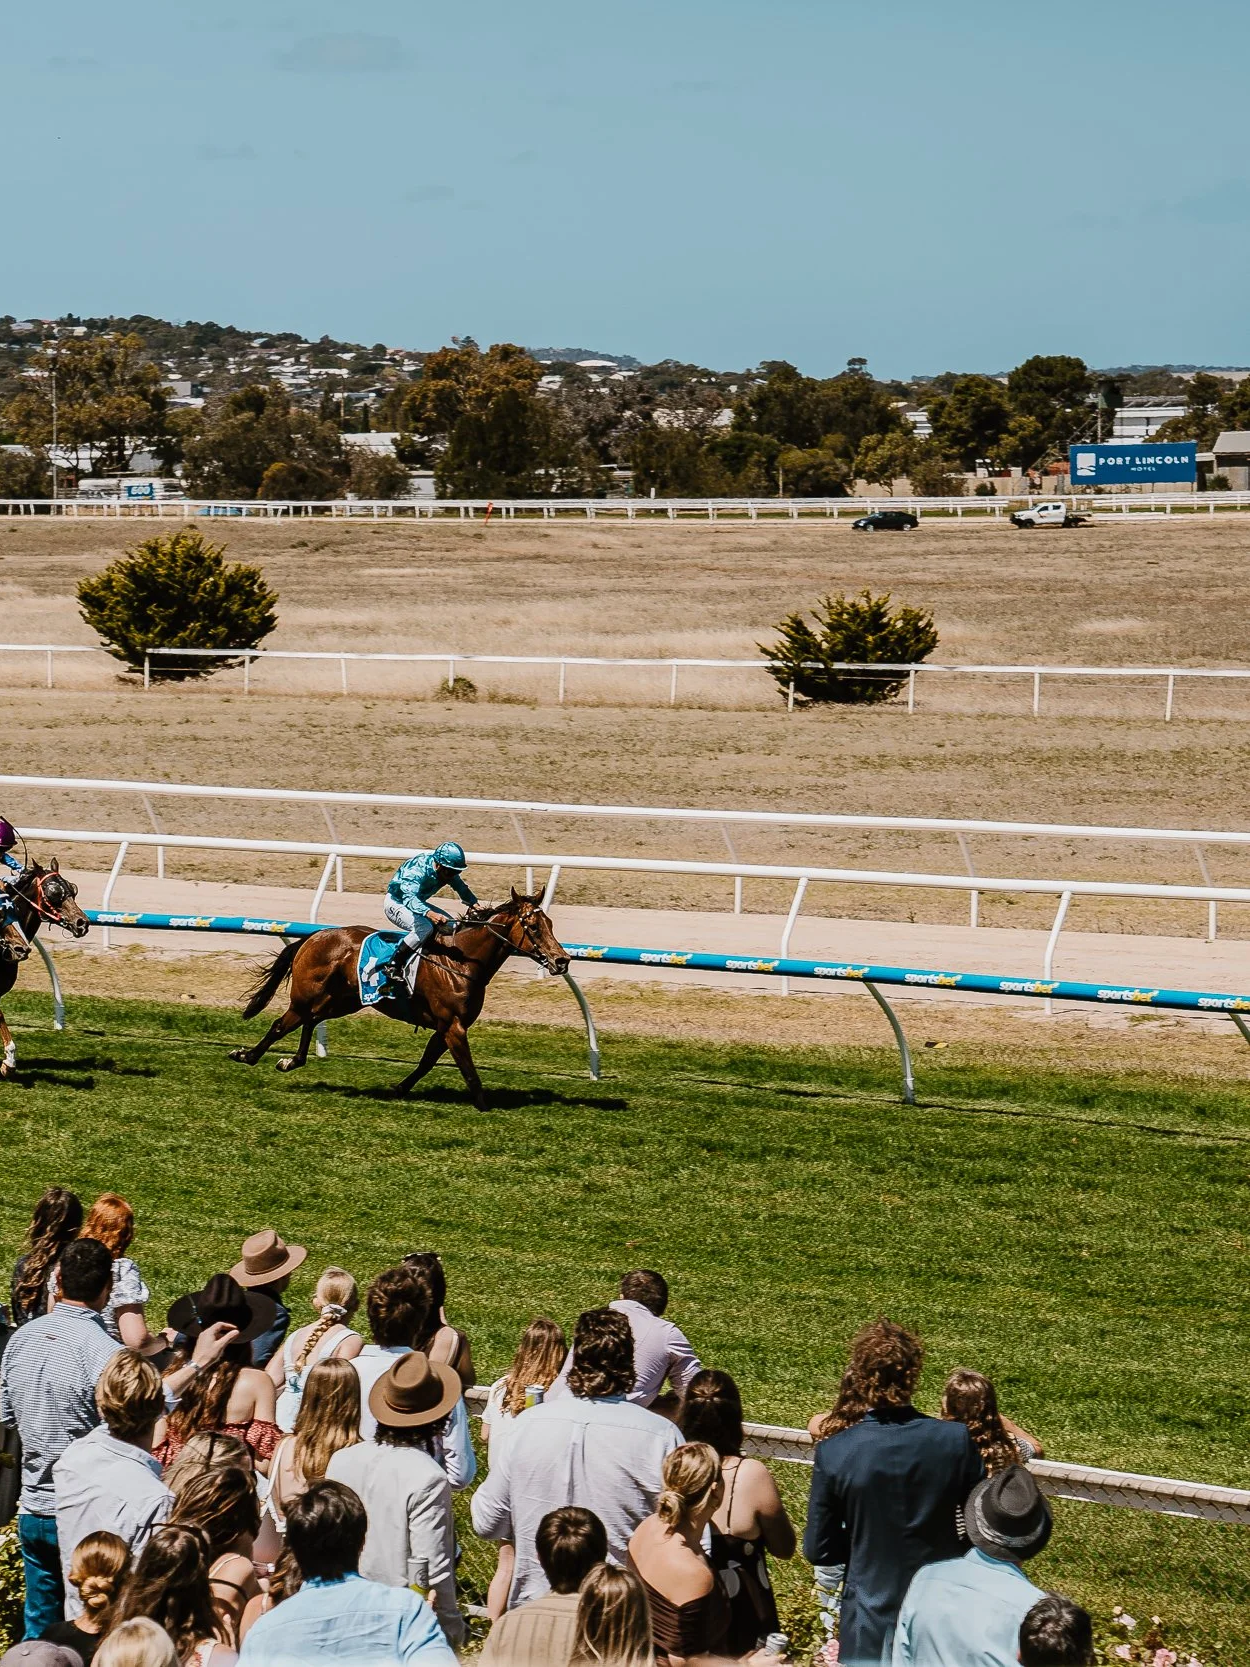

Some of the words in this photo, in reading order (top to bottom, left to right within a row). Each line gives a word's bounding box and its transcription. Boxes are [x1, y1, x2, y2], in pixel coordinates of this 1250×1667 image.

[1098, 457, 1131, 466] PORT
[1135, 455, 1189, 465] LINCOLN
[640, 953, 692, 965] sportsbet
[725, 959, 779, 972] sportsbet
[814, 966, 869, 979] sportsbet
[905, 973, 962, 986] sportsbet
[999, 981, 1059, 994] sportsbet
[1097, 989, 1159, 1002] sportsbet
[1198, 997, 1250, 1011] sportsbe
